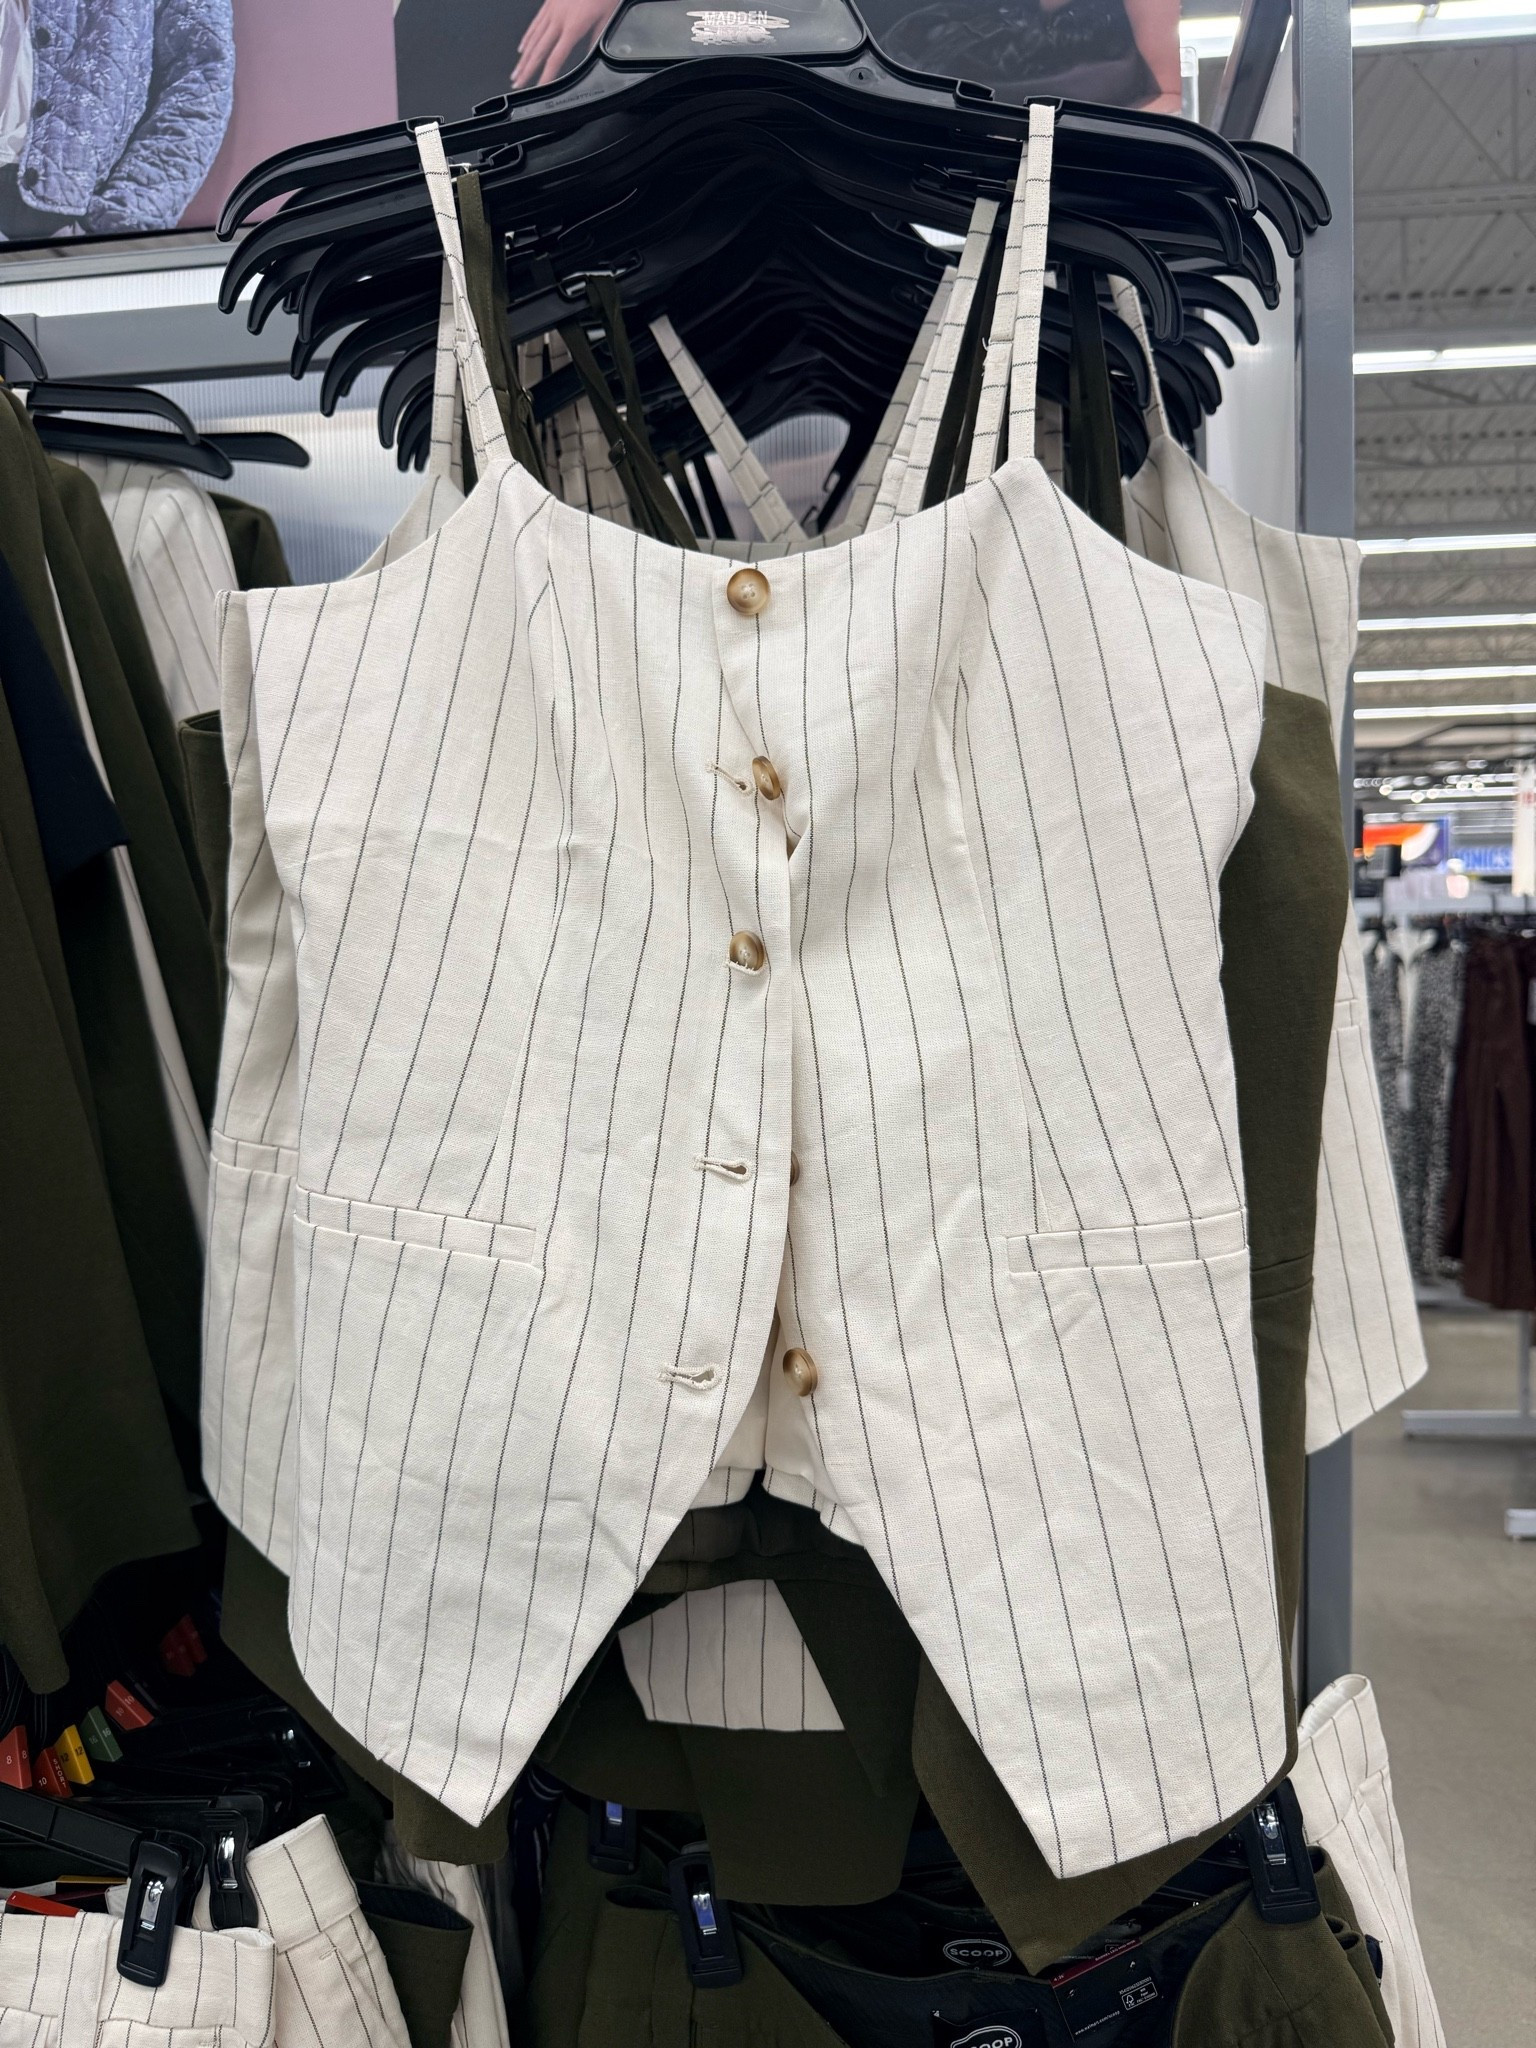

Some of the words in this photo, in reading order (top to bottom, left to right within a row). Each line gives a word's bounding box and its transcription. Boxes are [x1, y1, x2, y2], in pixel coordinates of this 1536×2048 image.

[703, 10, 768, 26] MADDEN
[125, 1695, 135, 1705] 10
[102, 1727, 112, 1738] 16
[21, 1750, 28, 1759] 8
[75, 1746, 84, 1756] 12
[6, 1755, 13, 1765] 8
[60, 1753, 69, 1763] 12
[53, 1758, 67, 1788] SHORT
[38, 1776, 48, 1787] 10
[949, 1948, 1004, 1957] SCOOP
